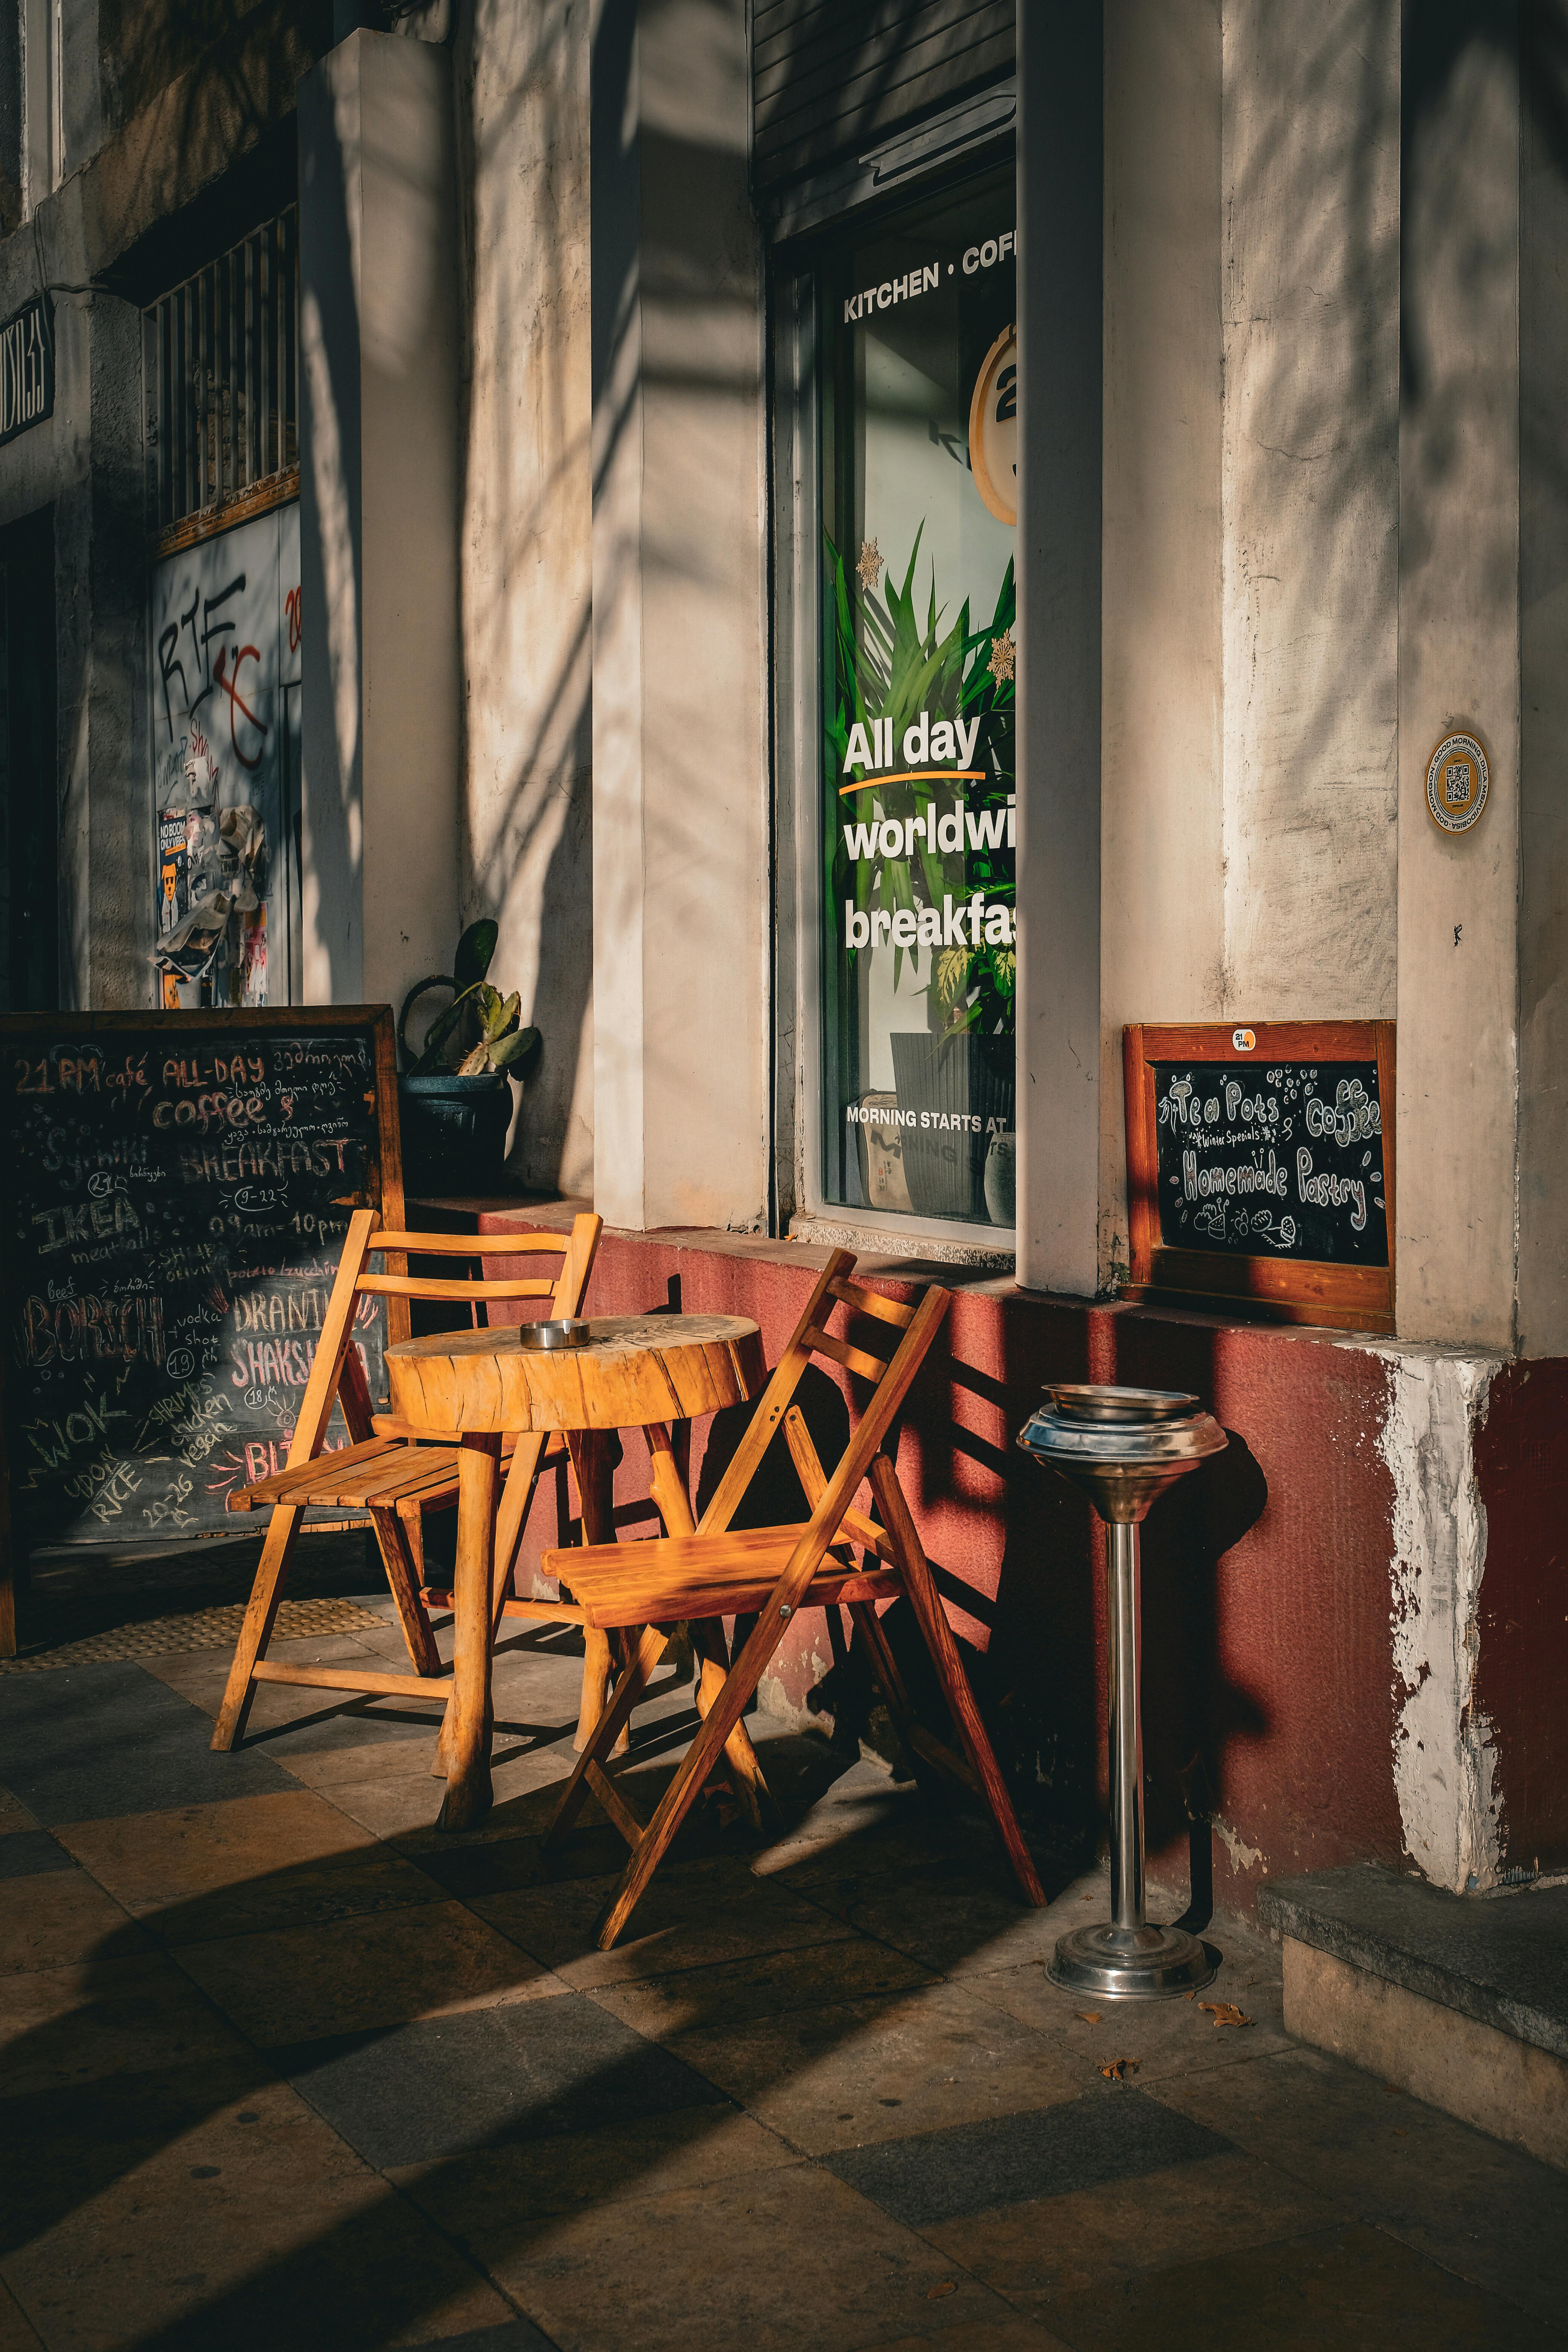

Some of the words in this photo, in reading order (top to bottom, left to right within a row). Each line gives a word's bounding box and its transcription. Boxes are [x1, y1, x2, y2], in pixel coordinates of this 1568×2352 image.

[844, 262, 939, 324] KITCHEN
[962, 230, 1017, 274] COF
[842, 717, 893, 773] All
[904, 711, 980, 770] day
[1434, 741, 1451, 763] GOOD
[1452, 737, 1481, 757] MORNING
[1428, 767, 1437, 813] MORGON
[1452, 785, 1487, 829] MSHVIDOBISA
[160, 824, 169, 839] NO
[1436, 811, 1449, 827] GOD
[161, 837, 172, 851] ONLY
[845, 893, 1016, 949] breakfa
[14, 1058, 55, 1095] 21
[58, 1057, 101, 1092] PM
[162, 1055, 265, 1088] ALL-DAY
[847, 1106, 917, 1127] MORNING
[920, 1111, 982, 1133] STARTS
[985, 1118, 1006, 1133] AT
[1170, 1080, 1219, 1125] Tea
[1225, 1081, 1279, 1122] Pots
[1202, 1134, 1225, 1148] Winter
[1183, 1149, 1288, 1201] Homemade
[1297, 1147, 1366, 1231] Pastry
[31, 1196, 141, 1254] IKEA
[47, 1276, 76, 1299] beef
[177, 1303, 222, 1327] vodka
[185, 1328, 220, 1346] shot
[27, 1391, 128, 1467] WOK
